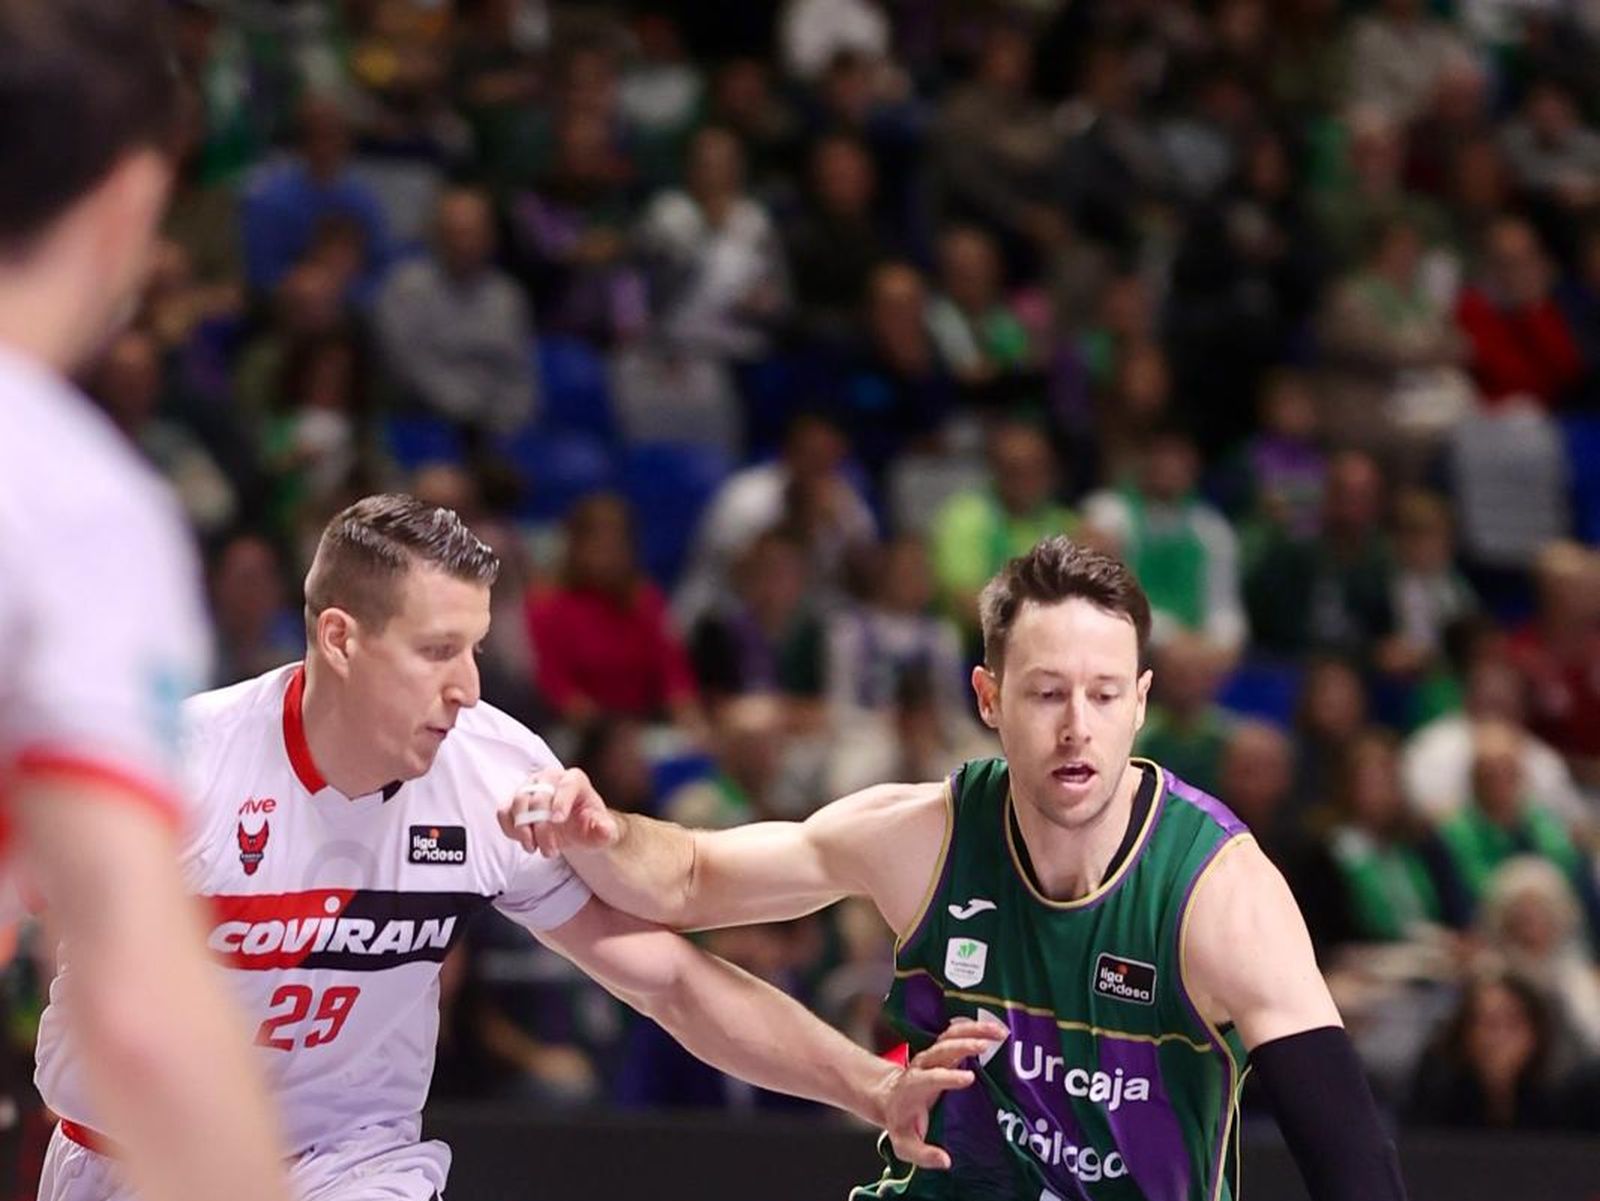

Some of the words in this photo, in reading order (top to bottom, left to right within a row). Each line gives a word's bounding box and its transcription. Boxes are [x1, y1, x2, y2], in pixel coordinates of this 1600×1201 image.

[413, 835, 438, 851] liga
[412, 848, 464, 862] endesa
[1100, 967, 1124, 984] liga
[1099, 980, 1150, 1001] endesa
[252, 985, 361, 1051] 29
